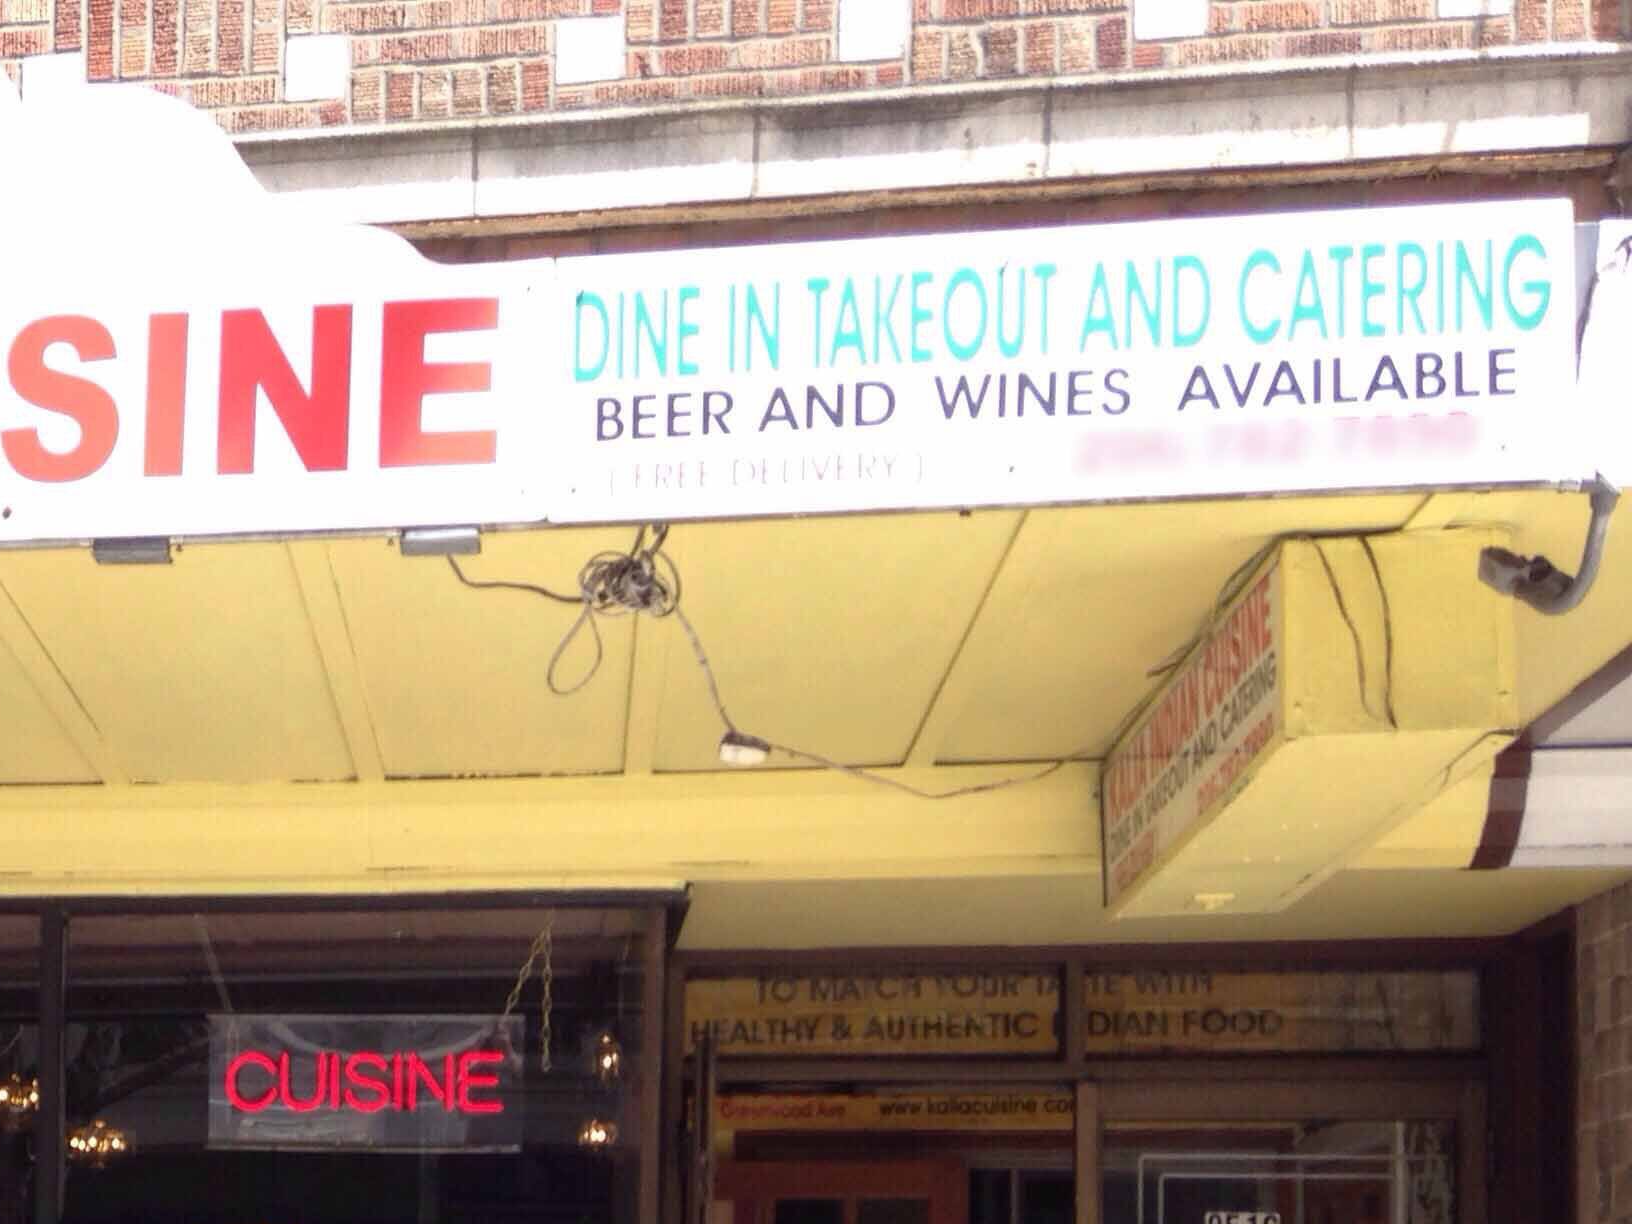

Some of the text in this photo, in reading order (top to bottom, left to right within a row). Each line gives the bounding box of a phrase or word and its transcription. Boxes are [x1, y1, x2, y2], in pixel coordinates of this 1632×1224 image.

[573, 233, 1551, 383] DINE IN TAKEOUT AND CATERING
[595, 348, 1516, 442] BEER AND WINES AVAILABLE
[1182, 1007, 1285, 1038] FOOD
[224, 1050, 506, 1114] CUISINE
